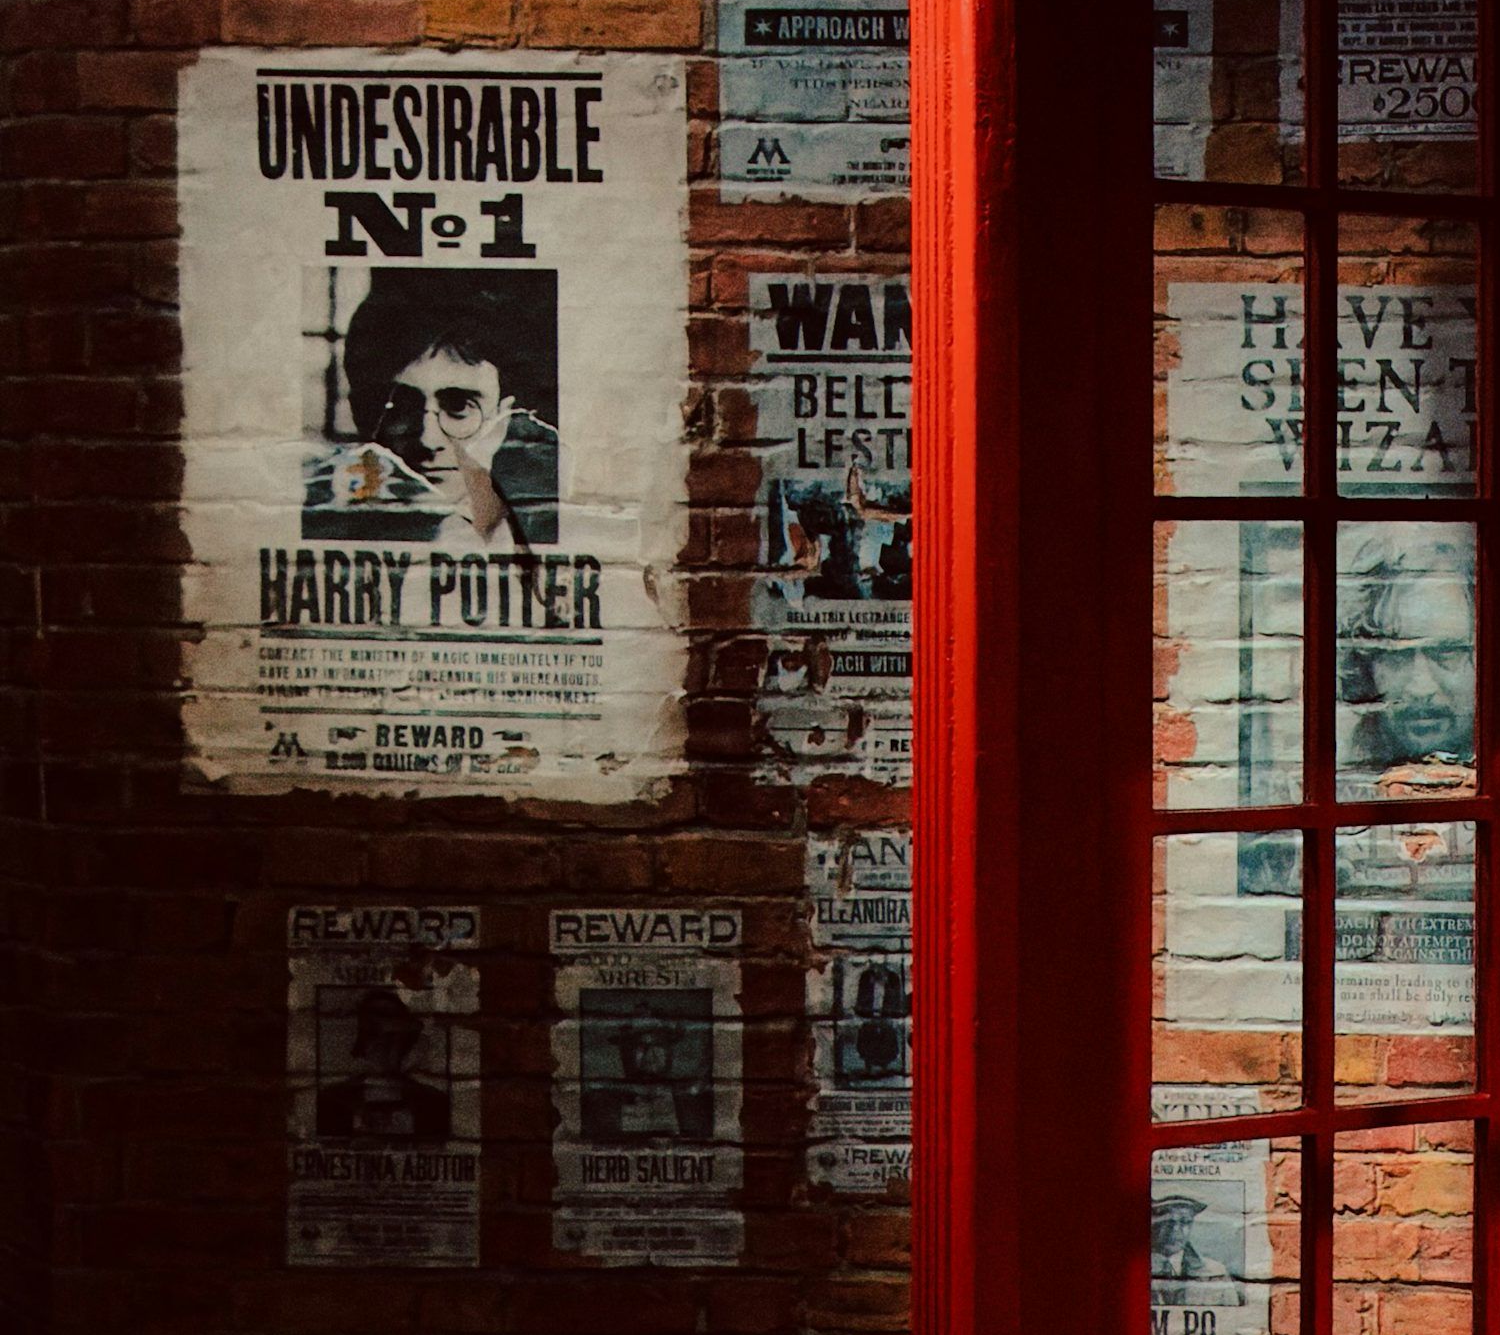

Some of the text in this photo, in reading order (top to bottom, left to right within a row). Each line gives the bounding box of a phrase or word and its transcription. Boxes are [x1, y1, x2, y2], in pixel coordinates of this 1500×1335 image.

[777, 17, 885, 40] APPROACH
[256, 83, 604, 183] UNDESIRABLE
[1241, 293, 1434, 350] HVE
[259, 548, 602, 630] HARRY POTTER
[432, 651, 469, 664] MAGIC
[475, 651, 559, 665] IMMEDIATELY
[582, 654, 603, 667] YOU
[376, 723, 485, 749] REWARD
[293, 909, 476, 942] REWARD
[555, 914, 738, 943] REWARD
[1395, 973, 1442, 992] leading
[581, 1155, 716, 1183] HERB SALIENT
[1177, 1165, 1222, 1176] AMERICA
